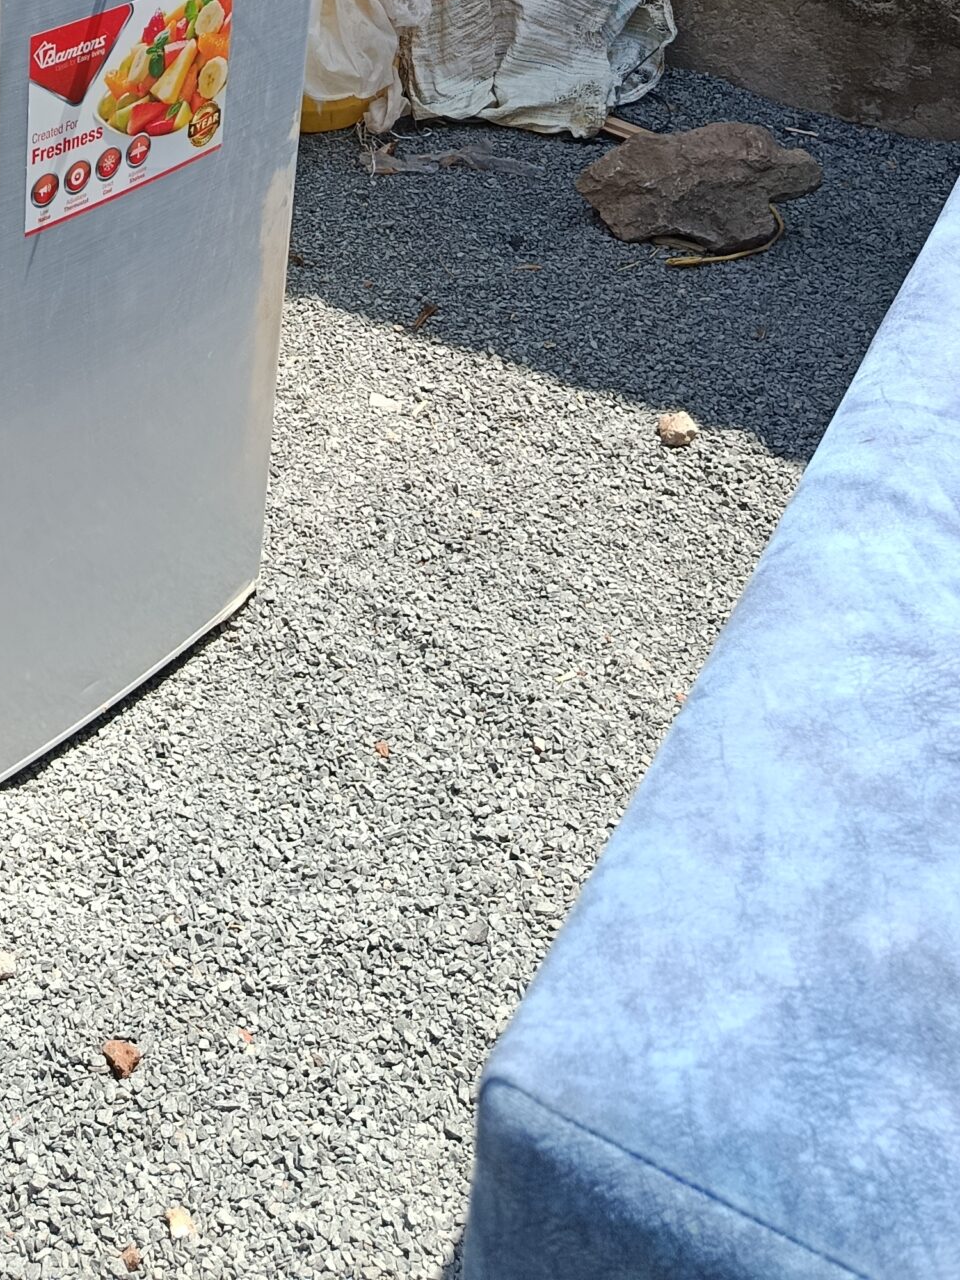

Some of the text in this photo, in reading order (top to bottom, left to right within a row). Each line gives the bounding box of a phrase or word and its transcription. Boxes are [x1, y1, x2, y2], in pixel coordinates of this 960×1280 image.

[35, 34, 107, 69] Ramtons
[77, 53, 90, 63] Easy
[32, 120, 78, 144] Created For
[196, 112, 219, 131] YEAR
[32, 126, 103, 165] Freshness
